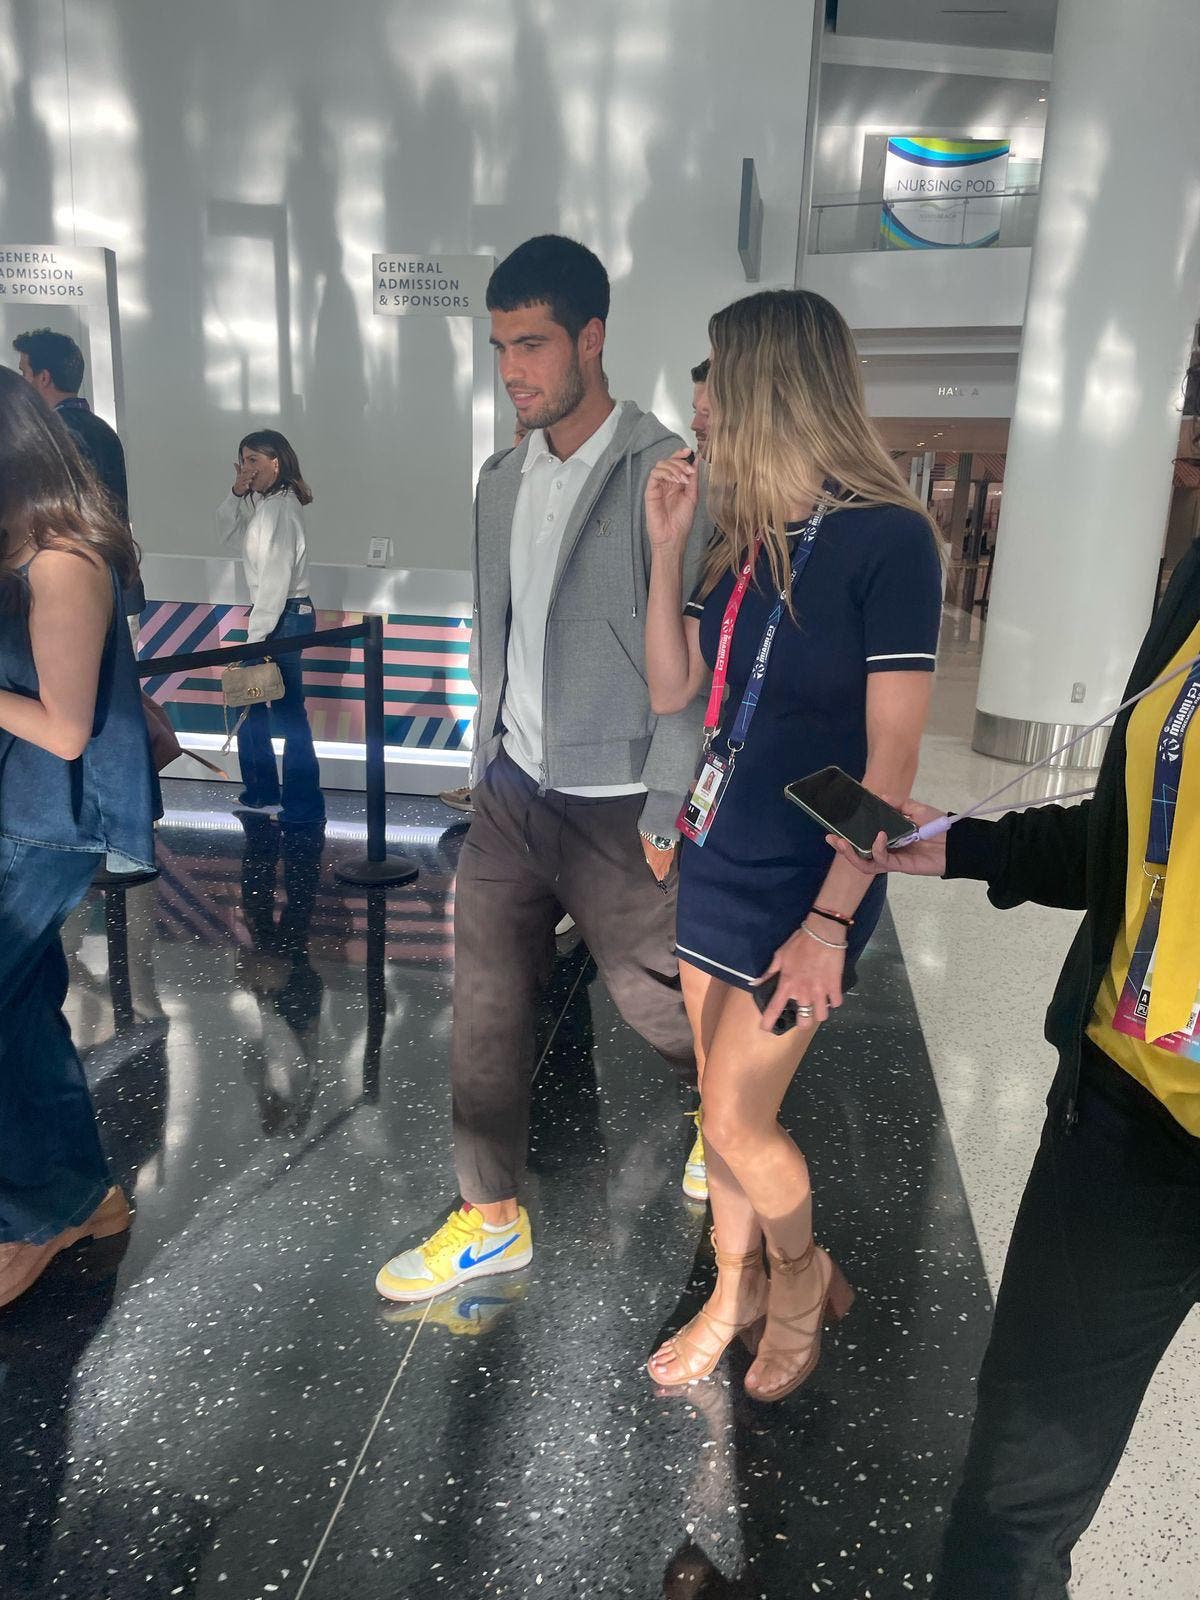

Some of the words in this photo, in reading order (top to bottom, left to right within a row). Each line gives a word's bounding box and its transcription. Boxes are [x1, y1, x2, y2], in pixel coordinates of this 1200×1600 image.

[897, 180, 962, 192] NURSING
[966, 180, 995, 192] POD
[378, 262, 443, 273] GENERAL
[0, 268, 73, 280] ADMISSION
[0, 284, 7, 295] &
[12, 284, 84, 296] SPONSORS
[378, 279, 459, 290] ADMISSION
[379, 295, 388, 306] &
[394, 295, 469, 308] SPONSORS
[759, 636, 772, 663] MIAMI
[1169, 698, 1194, 737] MIAMI
